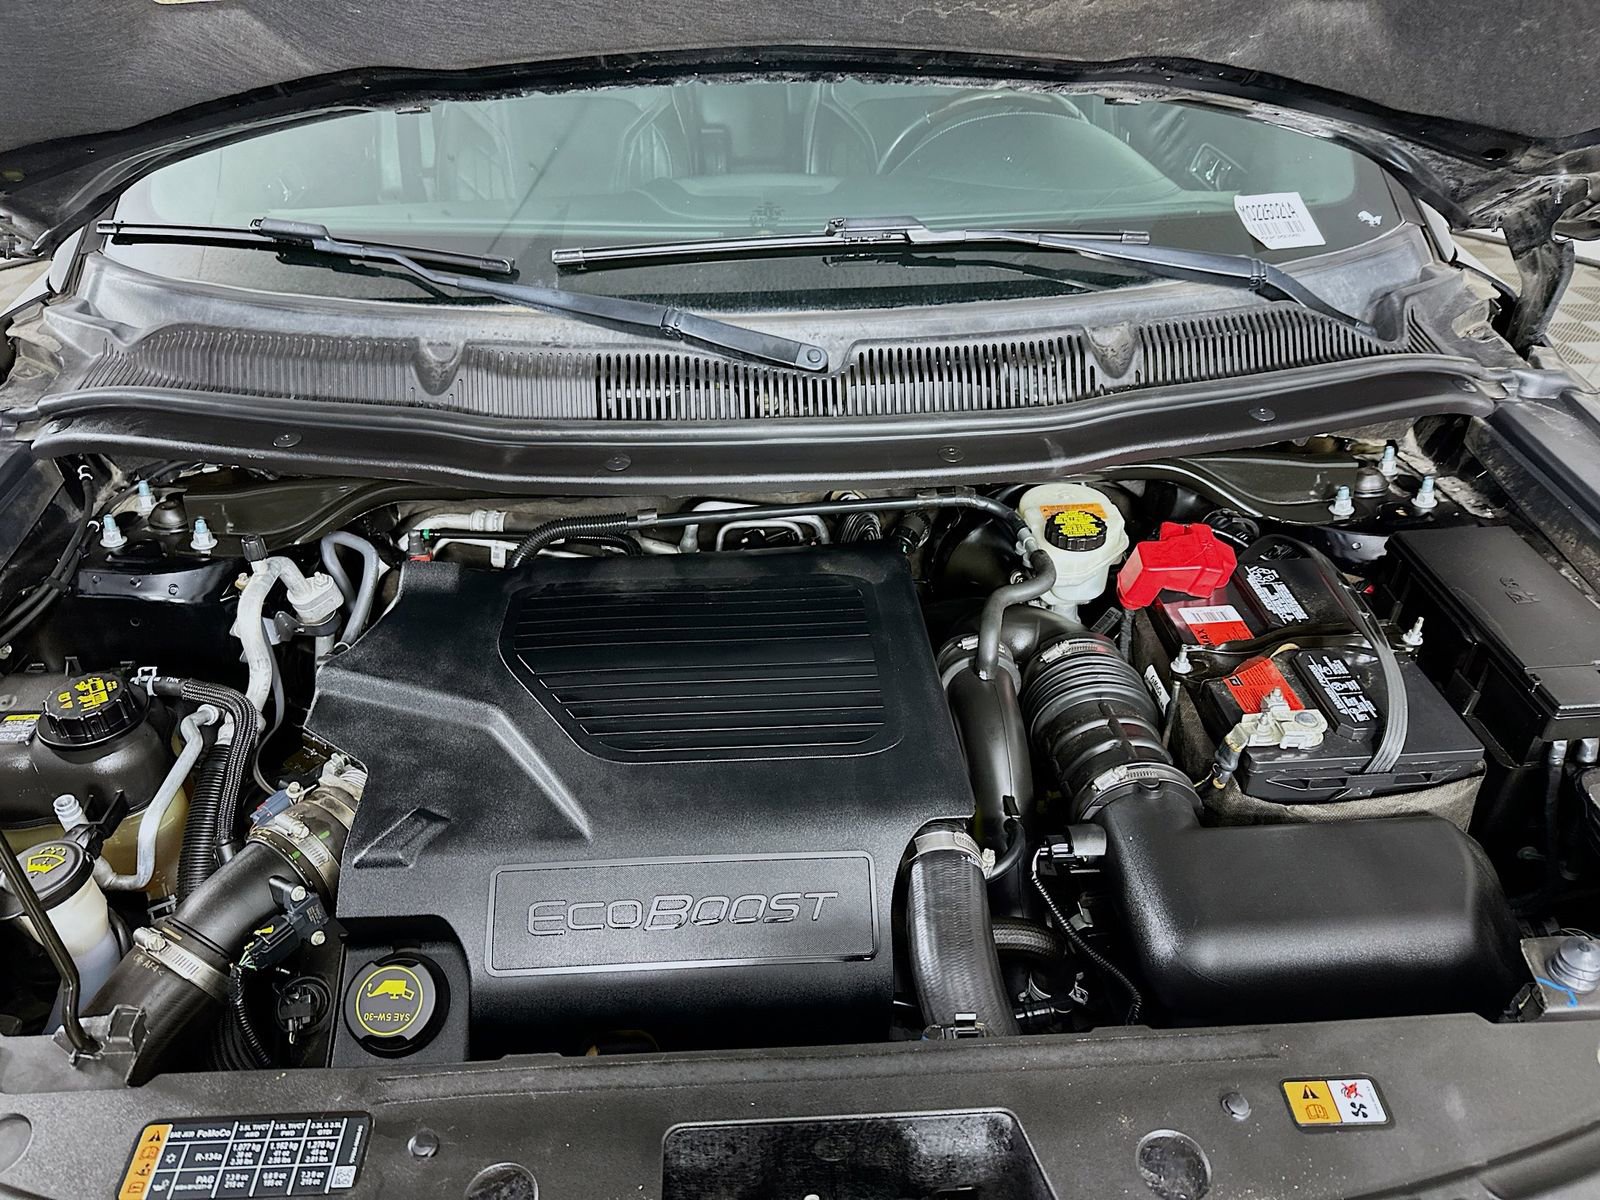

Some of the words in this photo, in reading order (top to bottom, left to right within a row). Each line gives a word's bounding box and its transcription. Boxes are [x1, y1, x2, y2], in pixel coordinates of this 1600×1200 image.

[364, 1012, 391, 1022] 5W-30
[394, 1012, 411, 1022] SAE
[196, 1128, 231, 1138] FoMoCo
[251, 1143, 261, 1152] kg
[289, 1141, 298, 1151] kg
[326, 1141, 336, 1150] kg
[195, 1153, 223, 1161] R-134a
